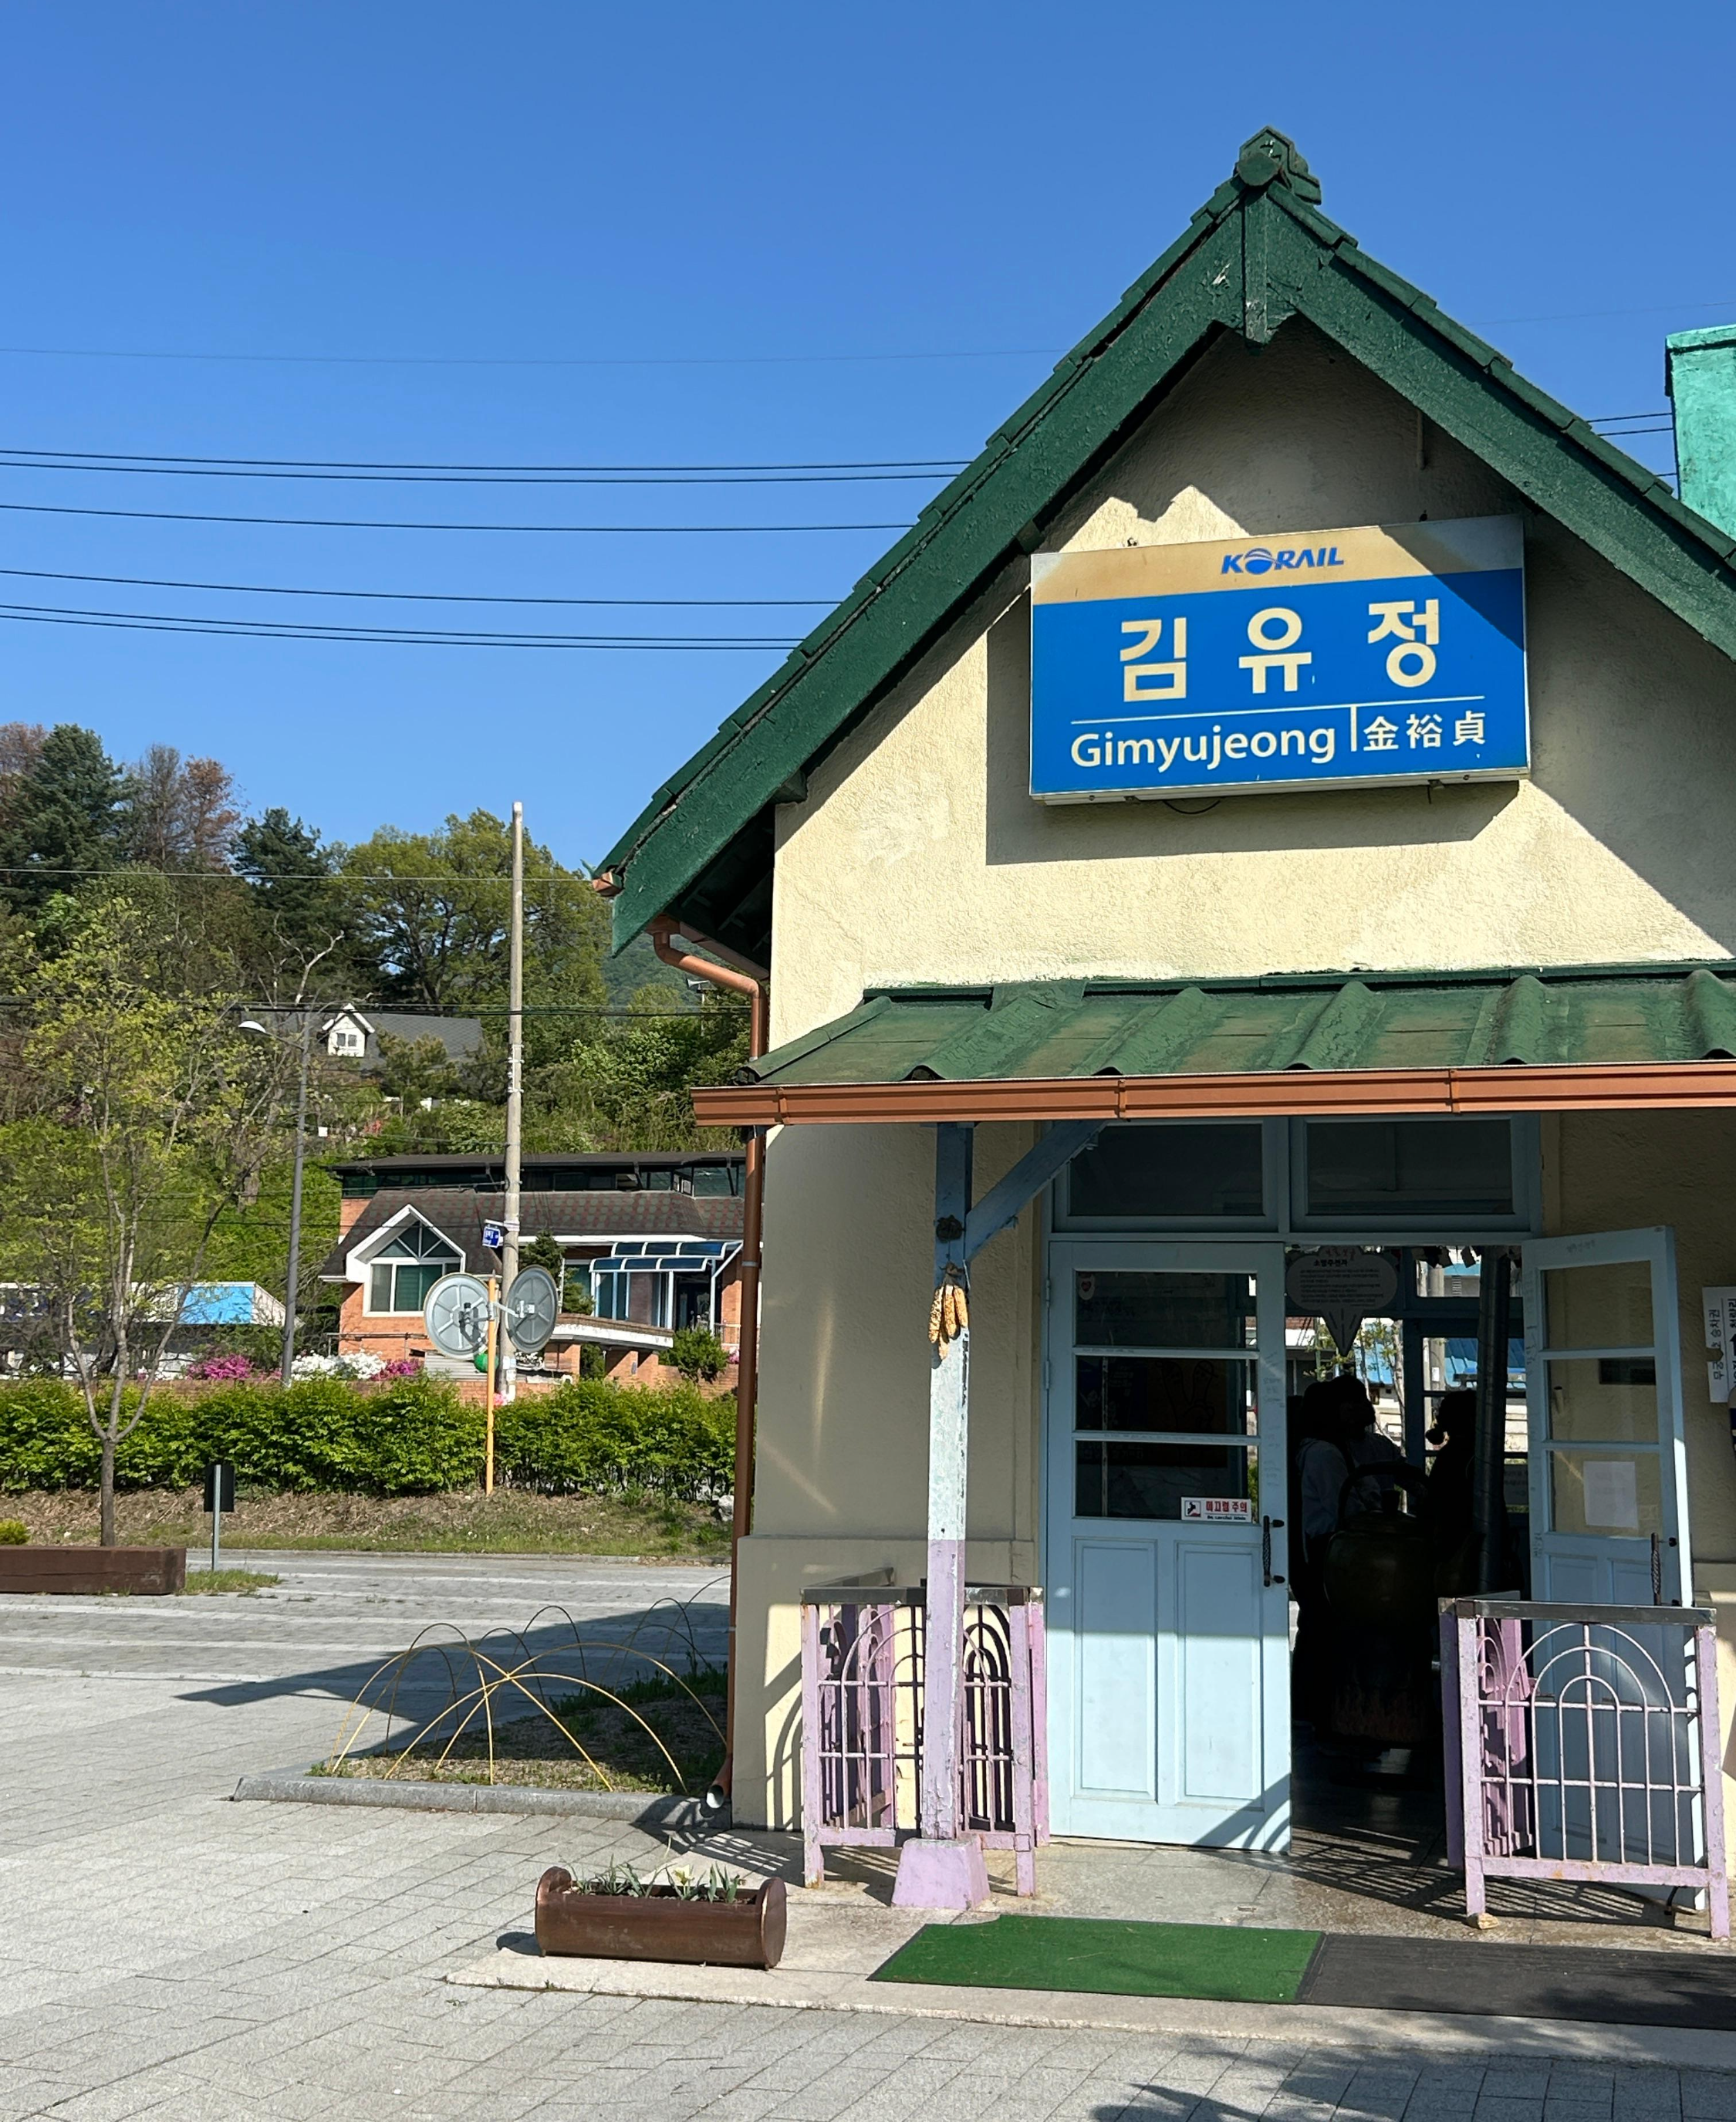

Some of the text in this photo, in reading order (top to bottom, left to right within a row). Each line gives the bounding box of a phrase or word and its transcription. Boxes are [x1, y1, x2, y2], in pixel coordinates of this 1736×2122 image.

[1221, 546, 1345, 575] KORAIL
[1120, 599, 1440, 703] 김유정
[1071, 724, 1336, 773] Gimyujeong
[1363, 709, 1487, 752] 金裕貞
[1711, 1341, 1724, 1380] 무궁호
[1232, 1502, 1247, 1513] 주의
